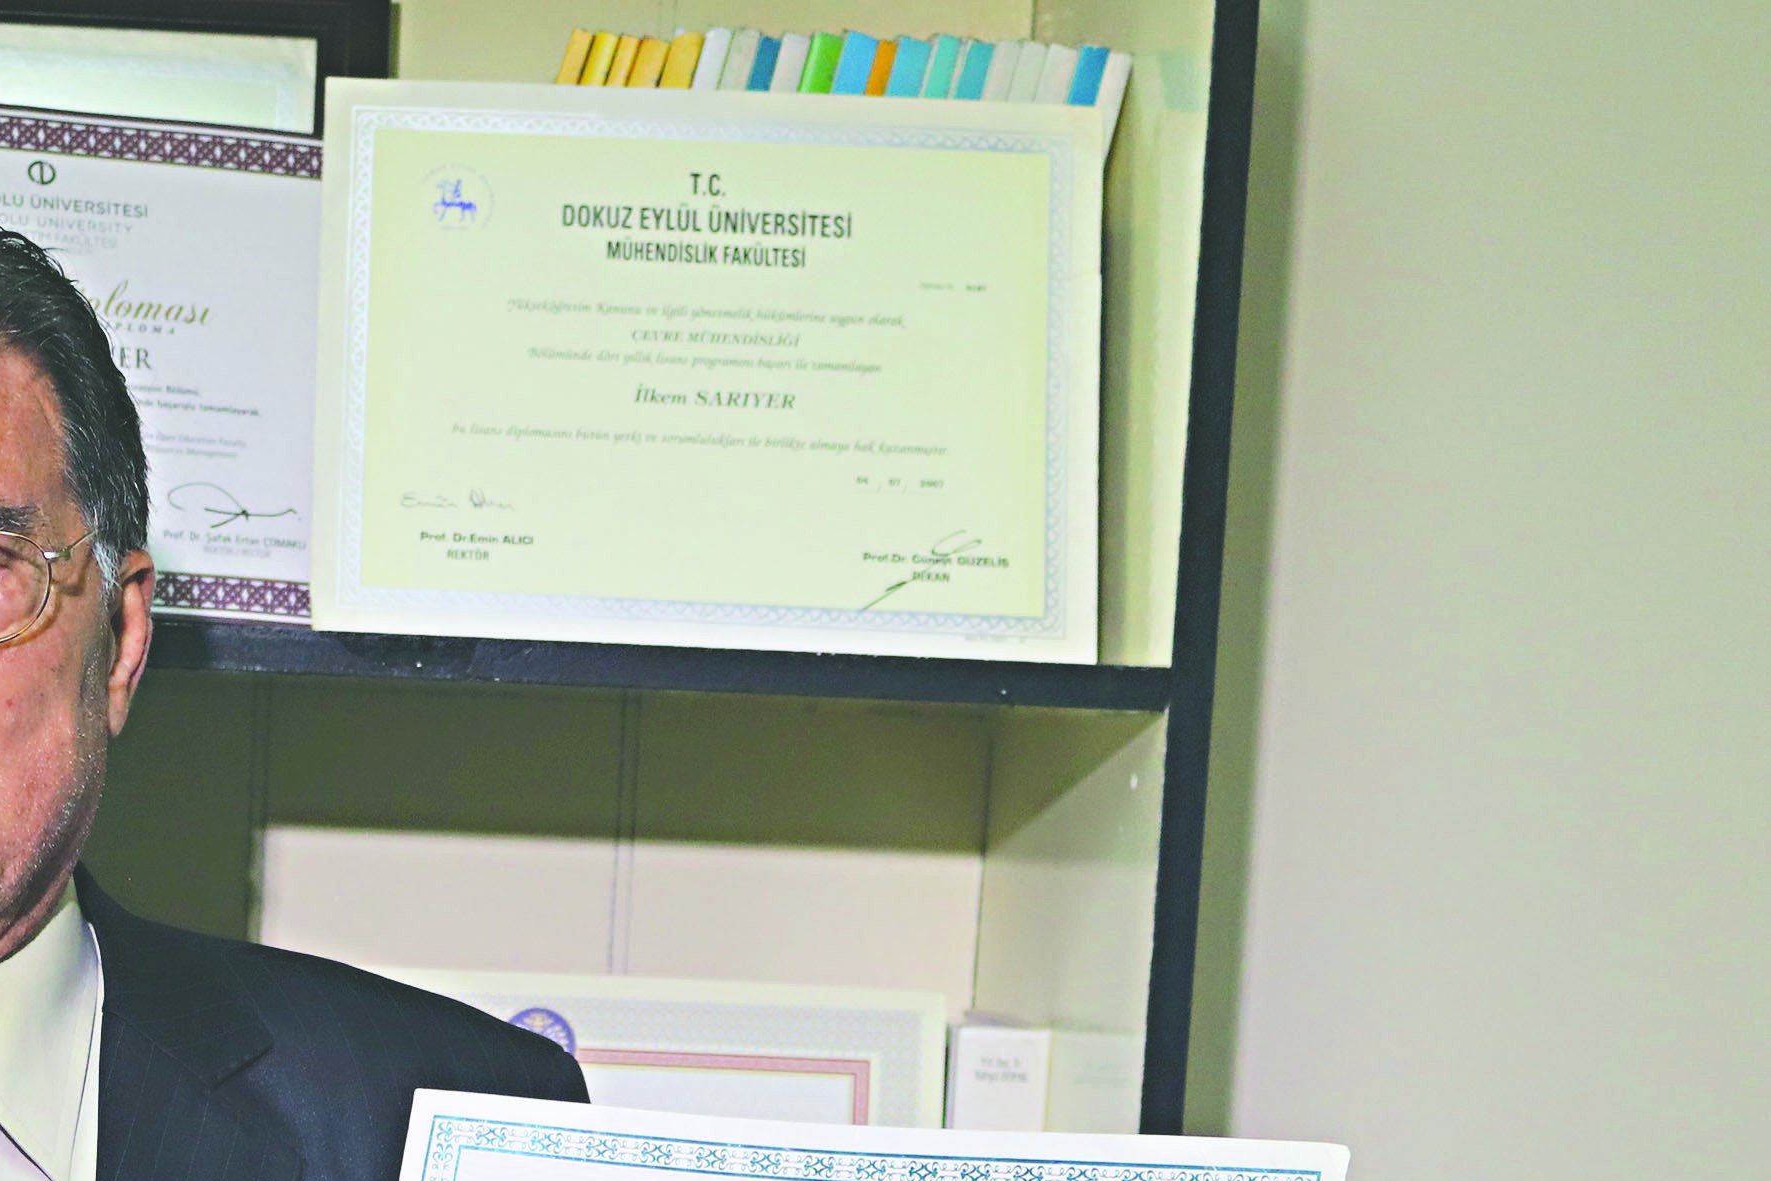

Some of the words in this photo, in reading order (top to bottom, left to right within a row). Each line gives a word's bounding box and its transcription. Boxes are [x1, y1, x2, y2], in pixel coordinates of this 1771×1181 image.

[691, 172, 726, 197] T.C.
[30, 194, 148, 218] ÜNİVERSİTESİ
[562, 203, 632, 230] DOKUZ
[640, 202, 701, 232] EYLÜL
[709, 204, 852, 238] ÜNİVERSİTESİ
[607, 236, 717, 264] MÜHENDİSLİK
[723, 243, 806, 268] FAKÜLTESİ
[635, 383, 687, 405] İlkem
[695, 390, 797, 410] SARIYER
